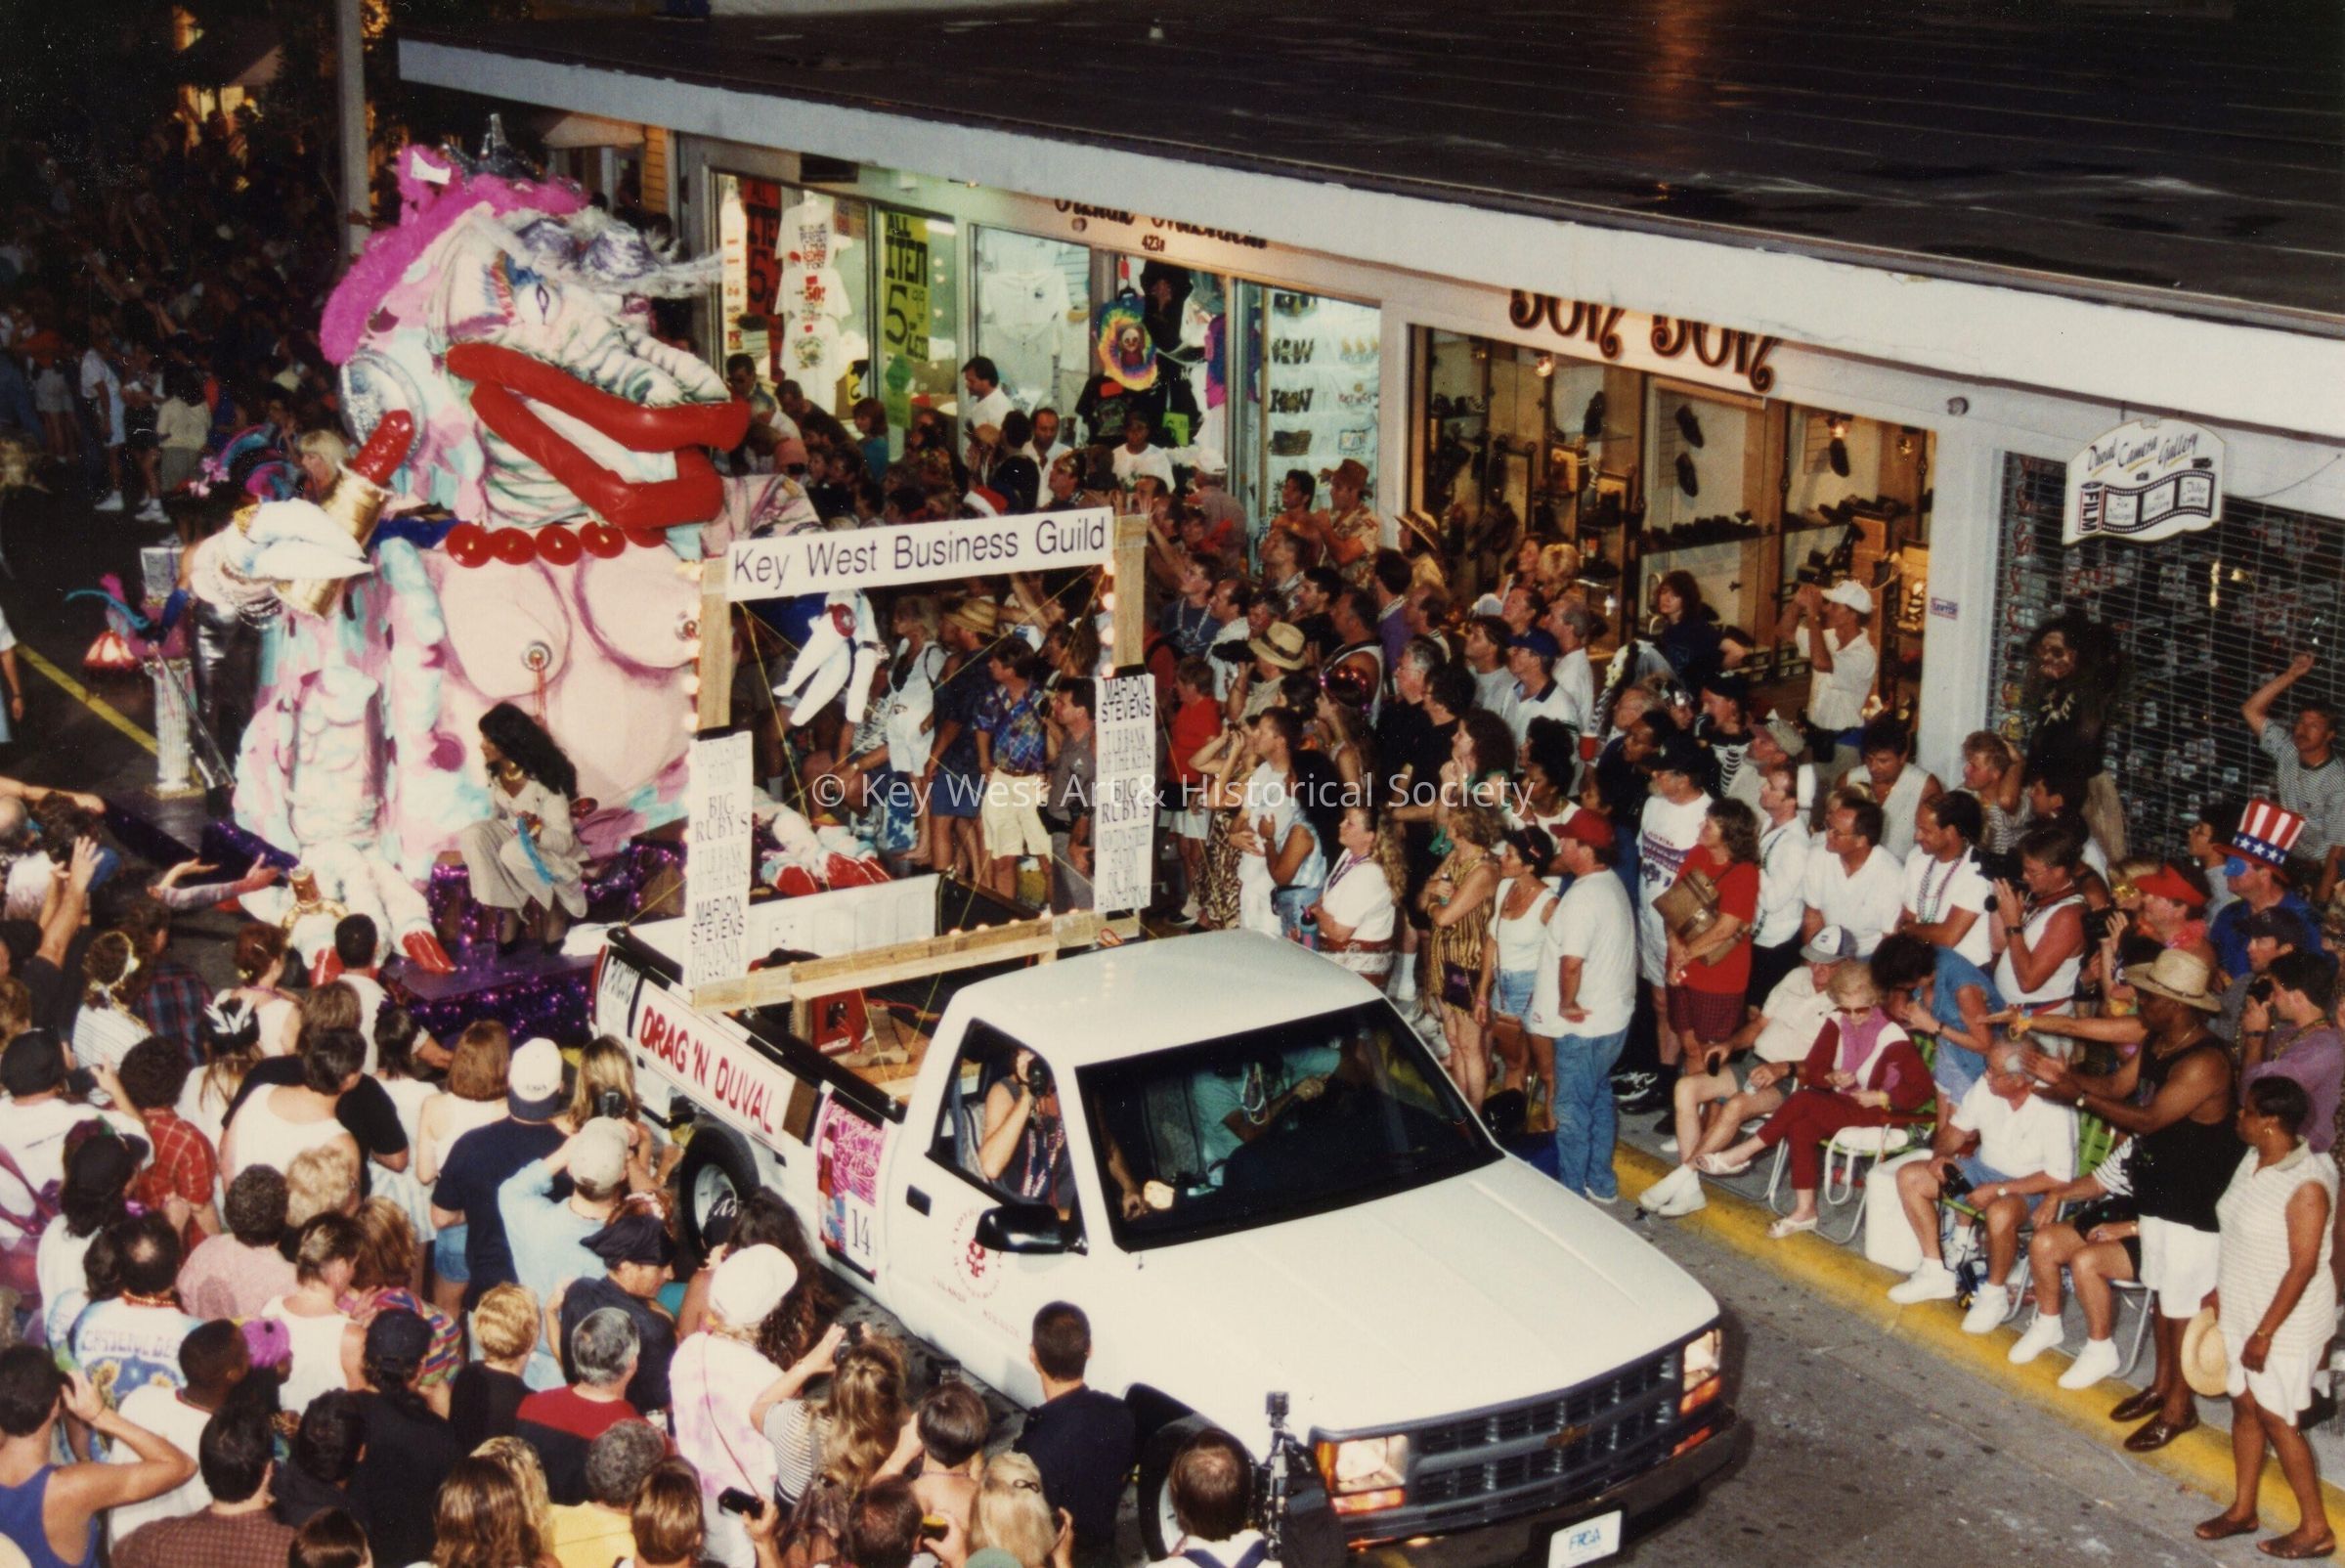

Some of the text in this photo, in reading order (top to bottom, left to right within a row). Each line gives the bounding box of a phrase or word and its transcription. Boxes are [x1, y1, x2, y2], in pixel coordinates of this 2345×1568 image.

[2088, 433, 2197, 471] Duval Camera Gallery
[2081, 490, 2100, 532] FILM
[734, 517, 1105, 590] Key West Business Guild
[1104, 676, 1148, 700] MARION
[1102, 696, 1151, 722] STEVENS
[709, 793, 734, 818] BIG
[1113, 778, 1138, 803] BIG
[1102, 797, 1151, 824] RUBY'S
[695, 812, 748, 843] RUBY'S
[695, 894, 741, 925] MARION
[691, 914, 744, 945] STEVENS
[640, 1005, 773, 1135] DRAG 'N DUVAL
[852, 1208, 872, 1257] 14
